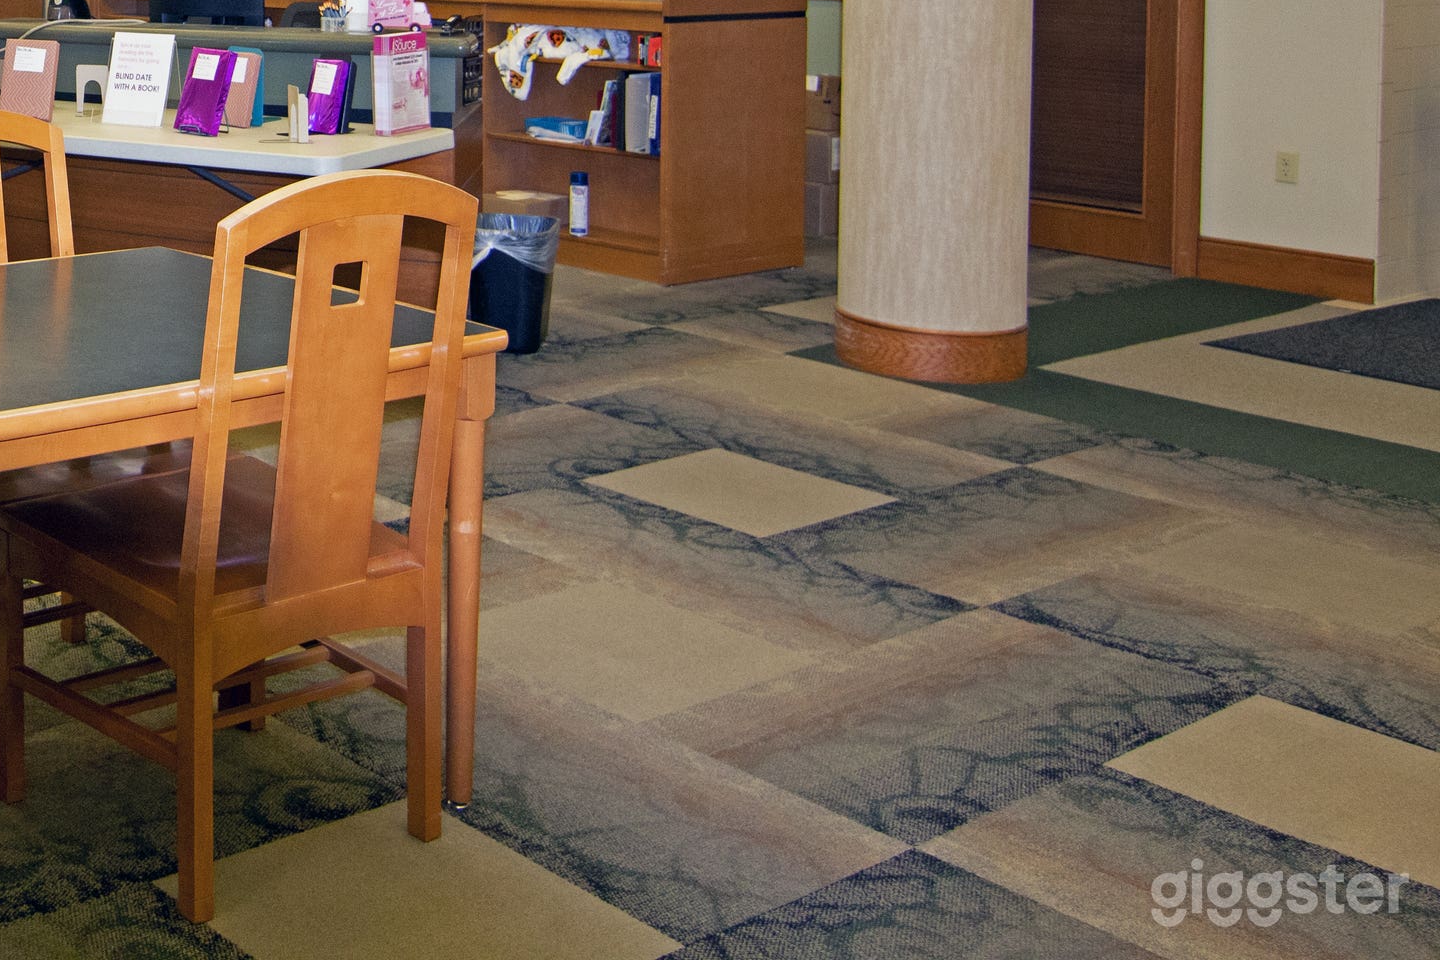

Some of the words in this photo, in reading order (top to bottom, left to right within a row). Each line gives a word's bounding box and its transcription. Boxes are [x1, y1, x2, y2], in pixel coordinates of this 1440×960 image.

[394, 39, 416, 51] Source
[115, 72, 134, 80] BLIND
[135, 73, 153, 81] DATE
[114, 83, 130, 91] WITH
[137, 84, 160, 93] BOOK!
